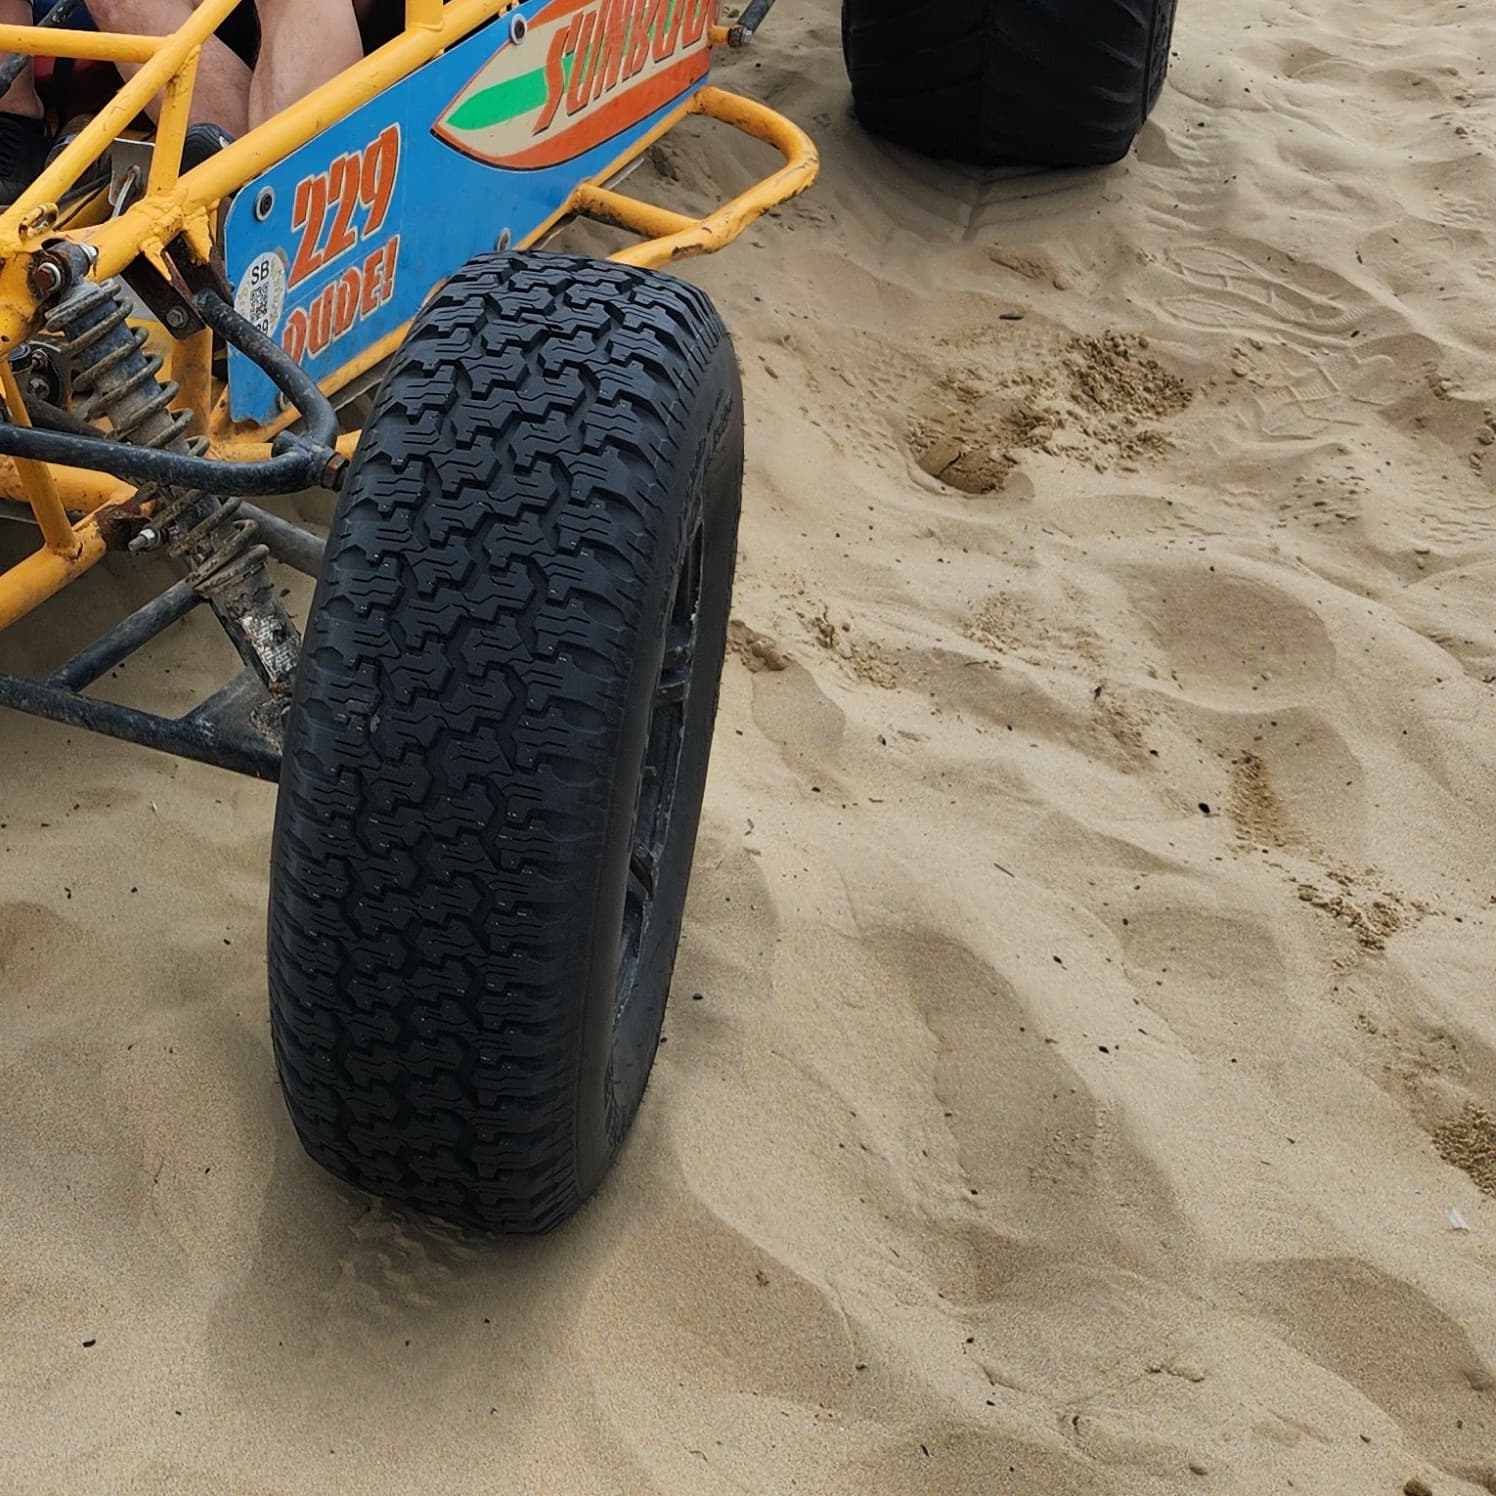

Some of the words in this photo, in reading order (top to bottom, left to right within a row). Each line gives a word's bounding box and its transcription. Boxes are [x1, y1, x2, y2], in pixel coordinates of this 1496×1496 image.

[288, 122, 401, 291] 229
[250, 260, 270, 285] SB
[280, 236, 400, 366] DUDE!
